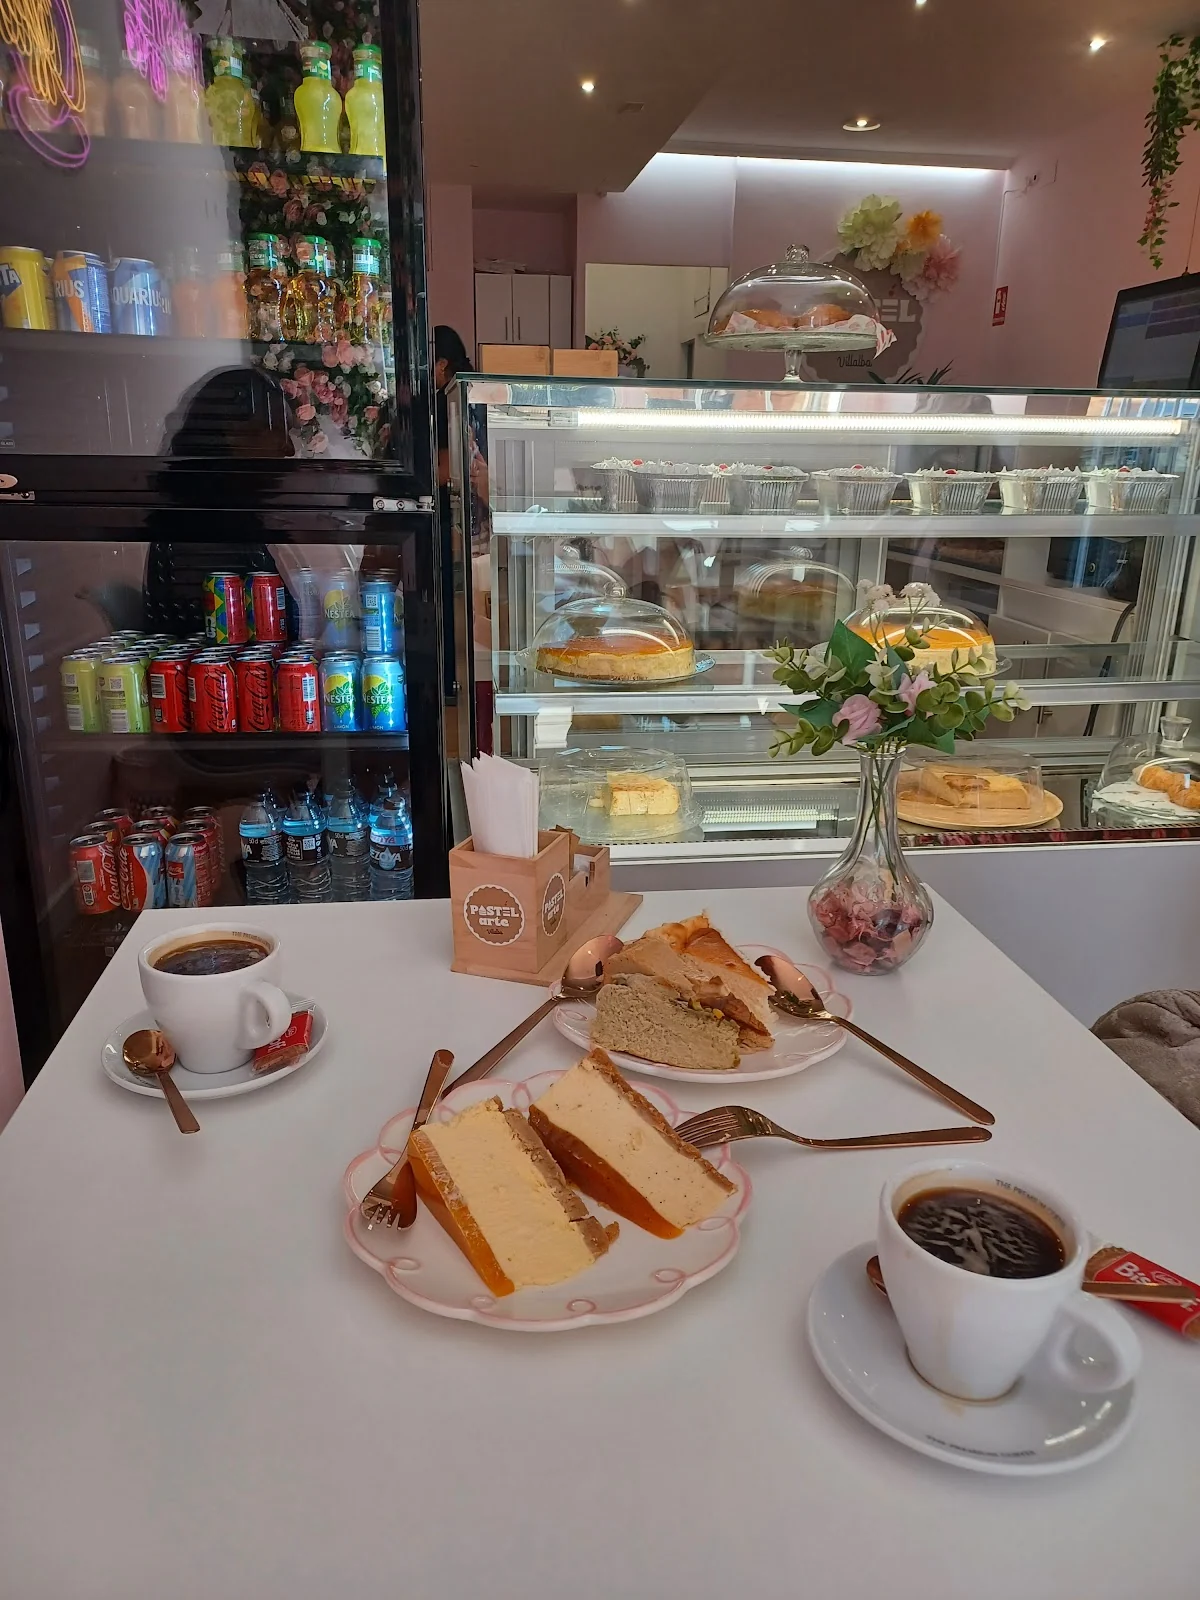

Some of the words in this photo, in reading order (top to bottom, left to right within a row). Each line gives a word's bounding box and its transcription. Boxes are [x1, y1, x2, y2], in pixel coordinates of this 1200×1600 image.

[837, 354, 872, 367] Villalba
[324, 609, 355, 619] NESTEA
[324, 693, 356, 704] NESTEA
[469, 905, 519, 917] PASTEL
[478, 917, 509, 927] arte
